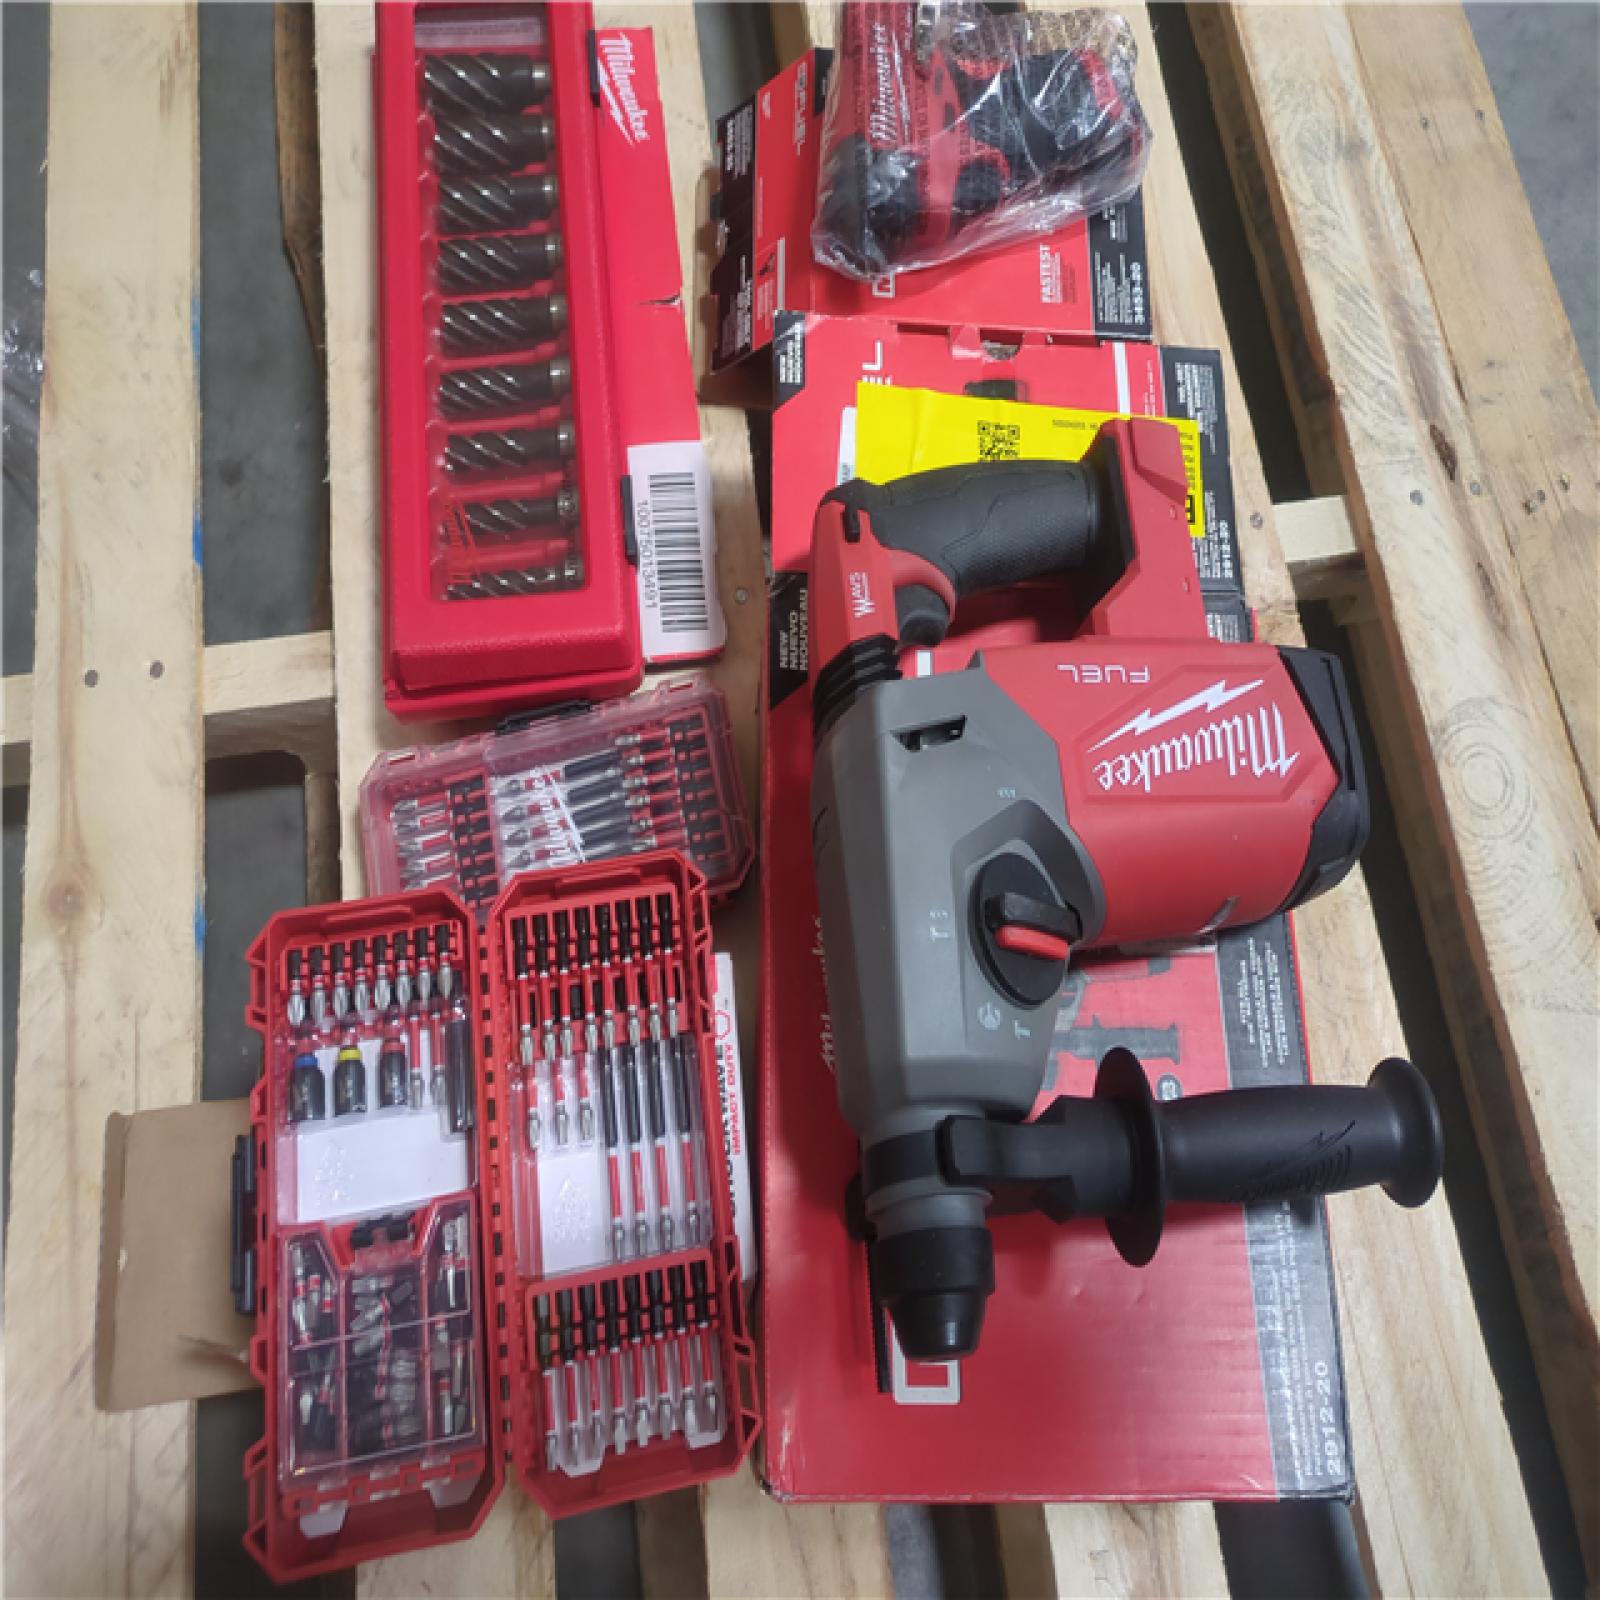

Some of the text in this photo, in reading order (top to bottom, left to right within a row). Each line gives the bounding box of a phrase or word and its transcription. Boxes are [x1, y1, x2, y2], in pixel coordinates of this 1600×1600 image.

[600, 32, 650, 142] Milwaukee
[1039, 243, 1051, 304] FASTEST
[779, 630, 788, 669] NEW
[789, 609, 798, 671] NUEVO
[799, 587, 808, 671] NOUVEAU
[1056, 664, 1151, 684] FUEL
[1092, 701, 1301, 792] Milwaukee
[725, 1044, 742, 1156] IMPACT DUTY
[1314, 1360, 1342, 1477] 2912-20
